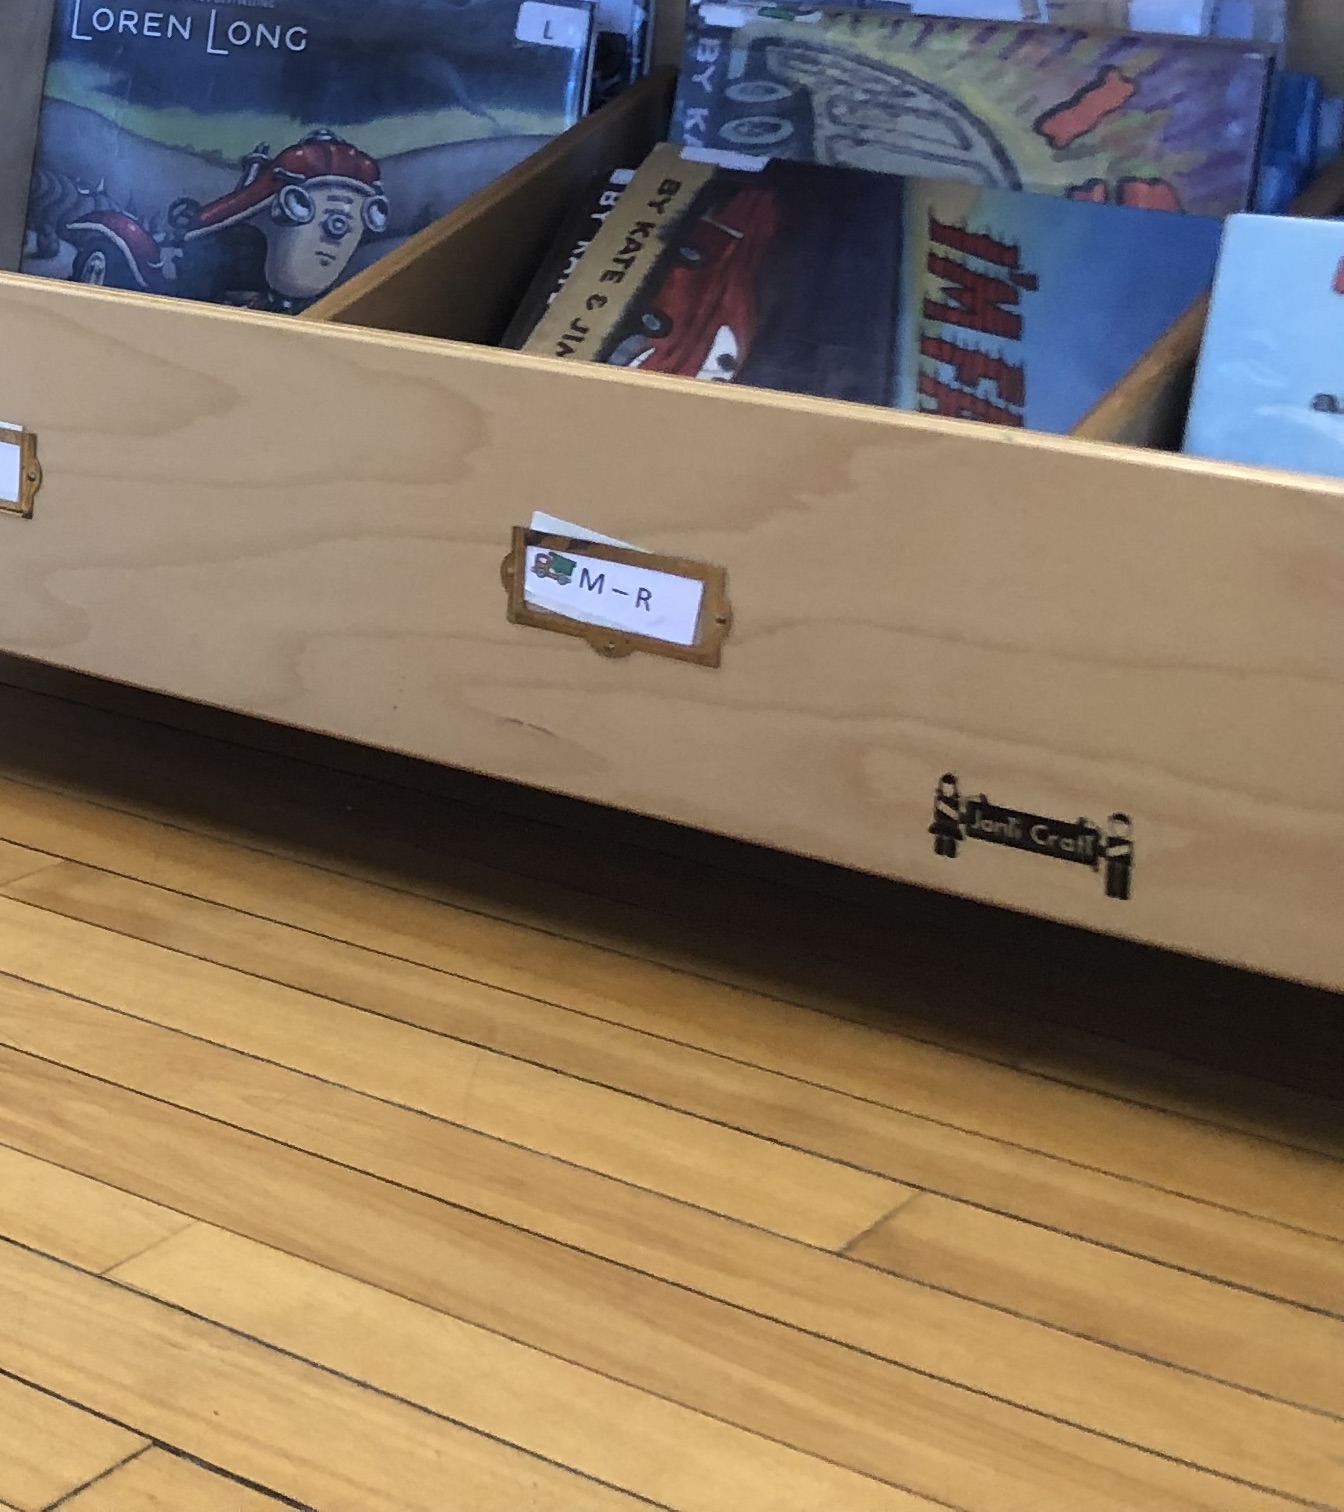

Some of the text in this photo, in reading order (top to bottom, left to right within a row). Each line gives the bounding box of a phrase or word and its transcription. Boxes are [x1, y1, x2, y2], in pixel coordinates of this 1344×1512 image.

[205, 8, 309, 56] LONG
[543, 20, 554, 40] L
[691, 38, 721, 93] BY
[648, 178, 685, 216] BY
[599, 221, 657, 286] KATE
